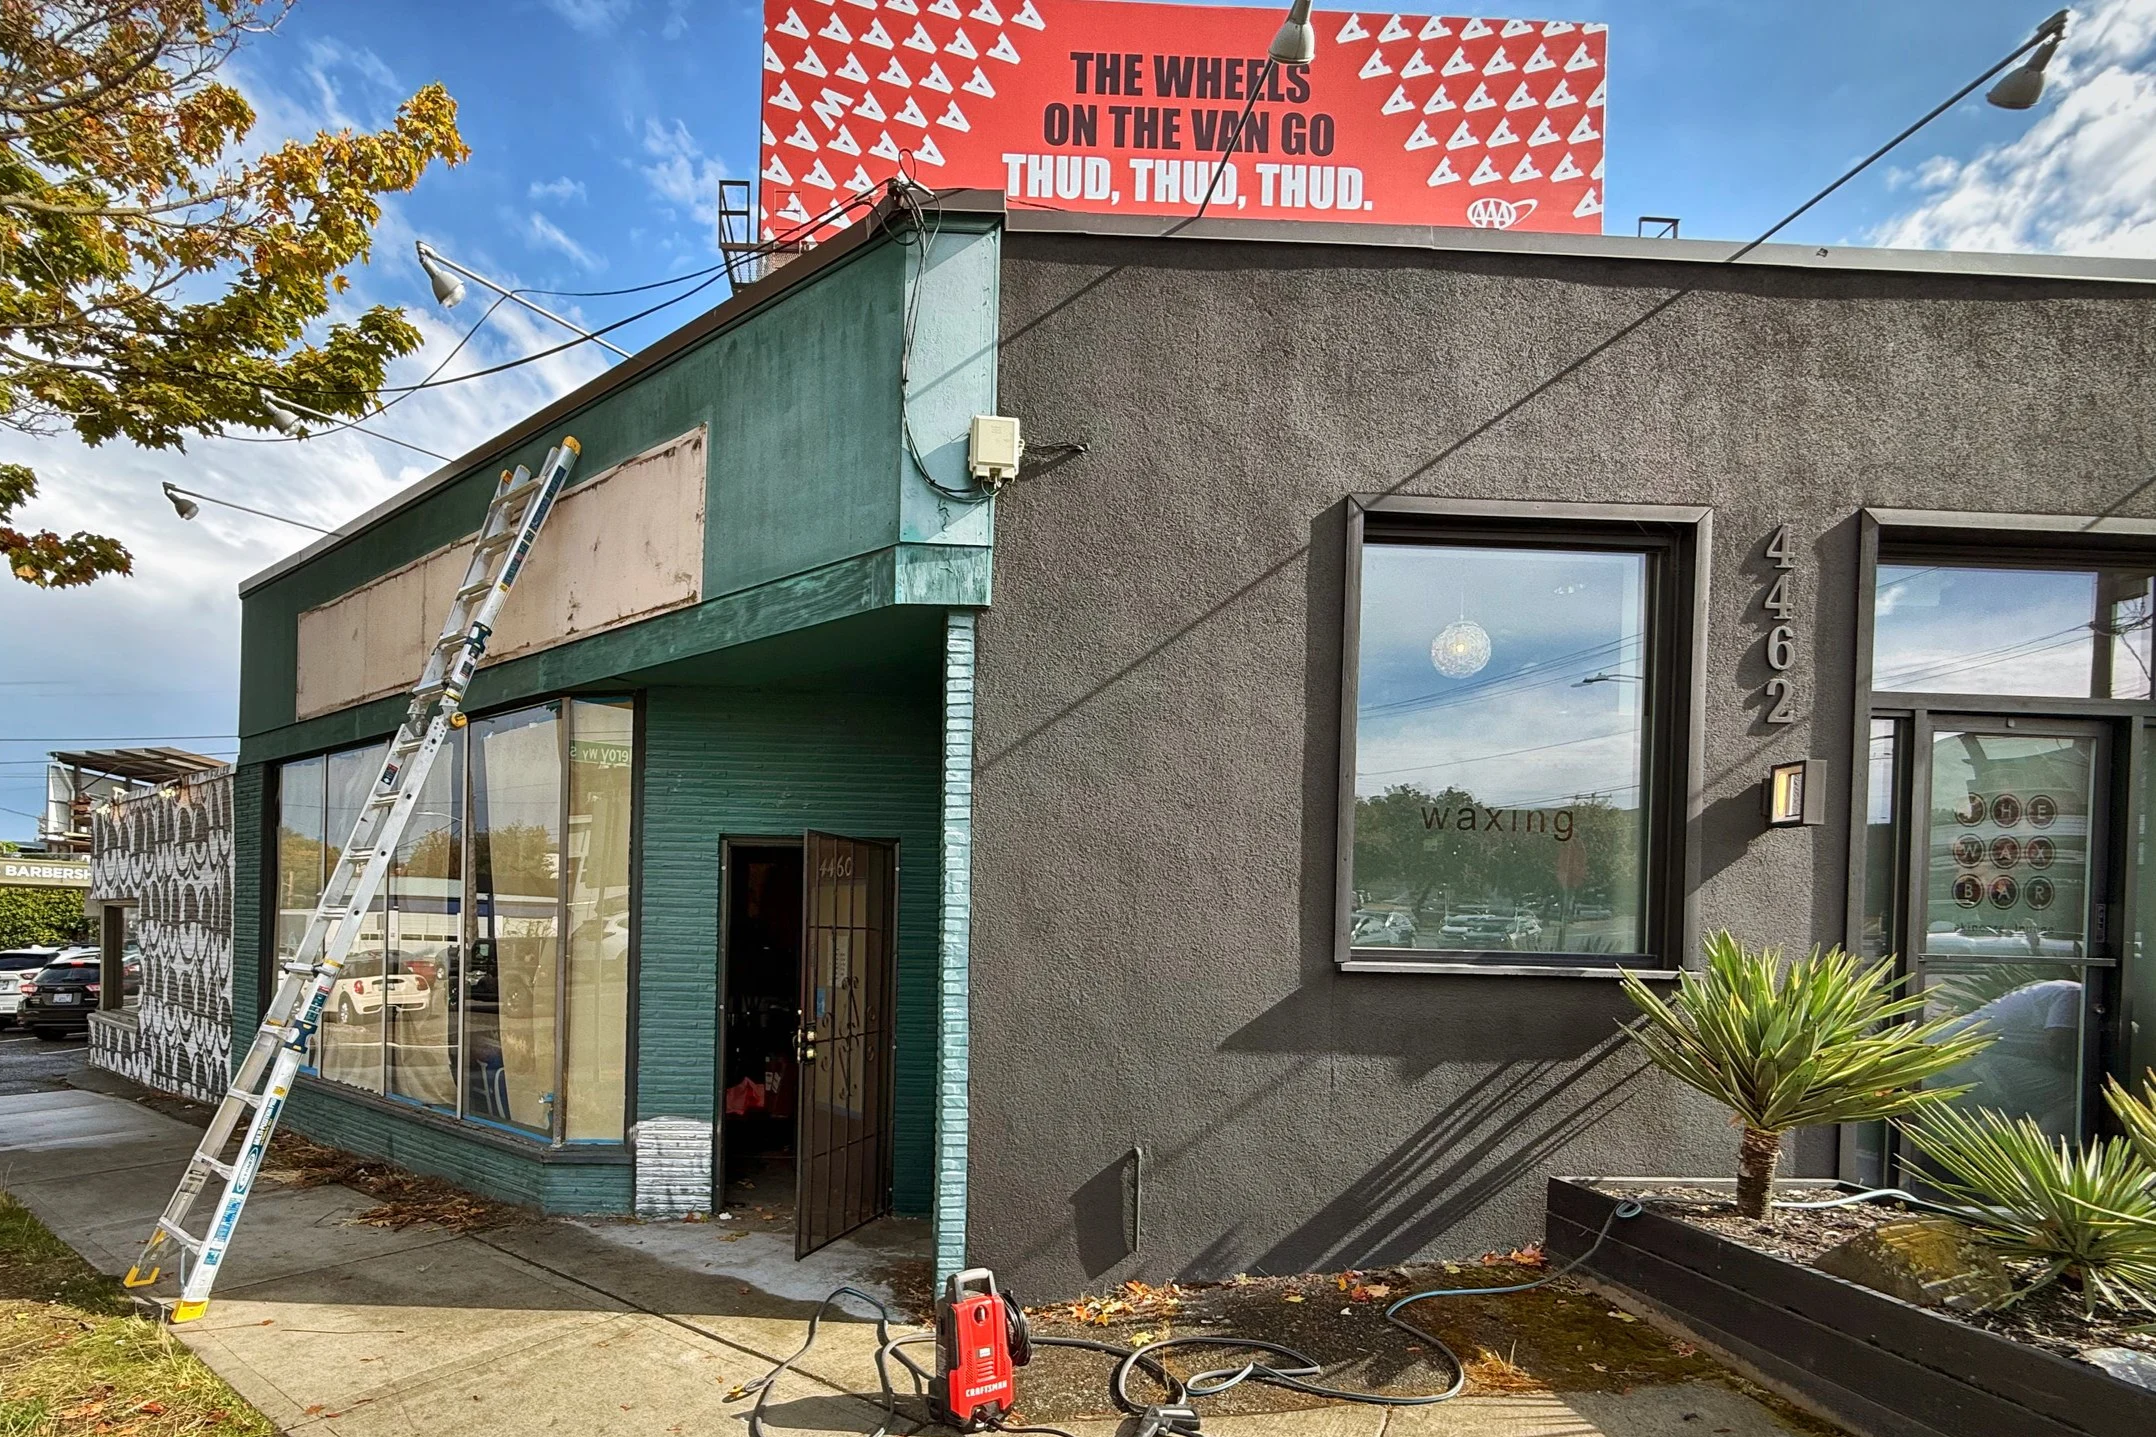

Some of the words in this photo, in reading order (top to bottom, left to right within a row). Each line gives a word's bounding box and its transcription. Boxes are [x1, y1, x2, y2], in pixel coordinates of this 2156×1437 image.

[1070, 52, 1143, 96] THE
[1152, 55, 1311, 103] WHEELS
[1043, 103, 1098, 148] ON
[1108, 106, 1181, 151] THE
[1191, 109, 1270, 154] VAN
[1281, 113, 1335, 157] GO
[1002, 153, 1120, 206] THUD,
[1129, 158, 1247, 210] THUD,
[1255, 163, 1374, 212] THUD.
[1471, 198, 1513, 230] AAA
[1764, 524, 1796, 724] 4462
[1421, 806, 1574, 842] waxing
[965, 1380, 1008, 1398] CRAFTSMAN
